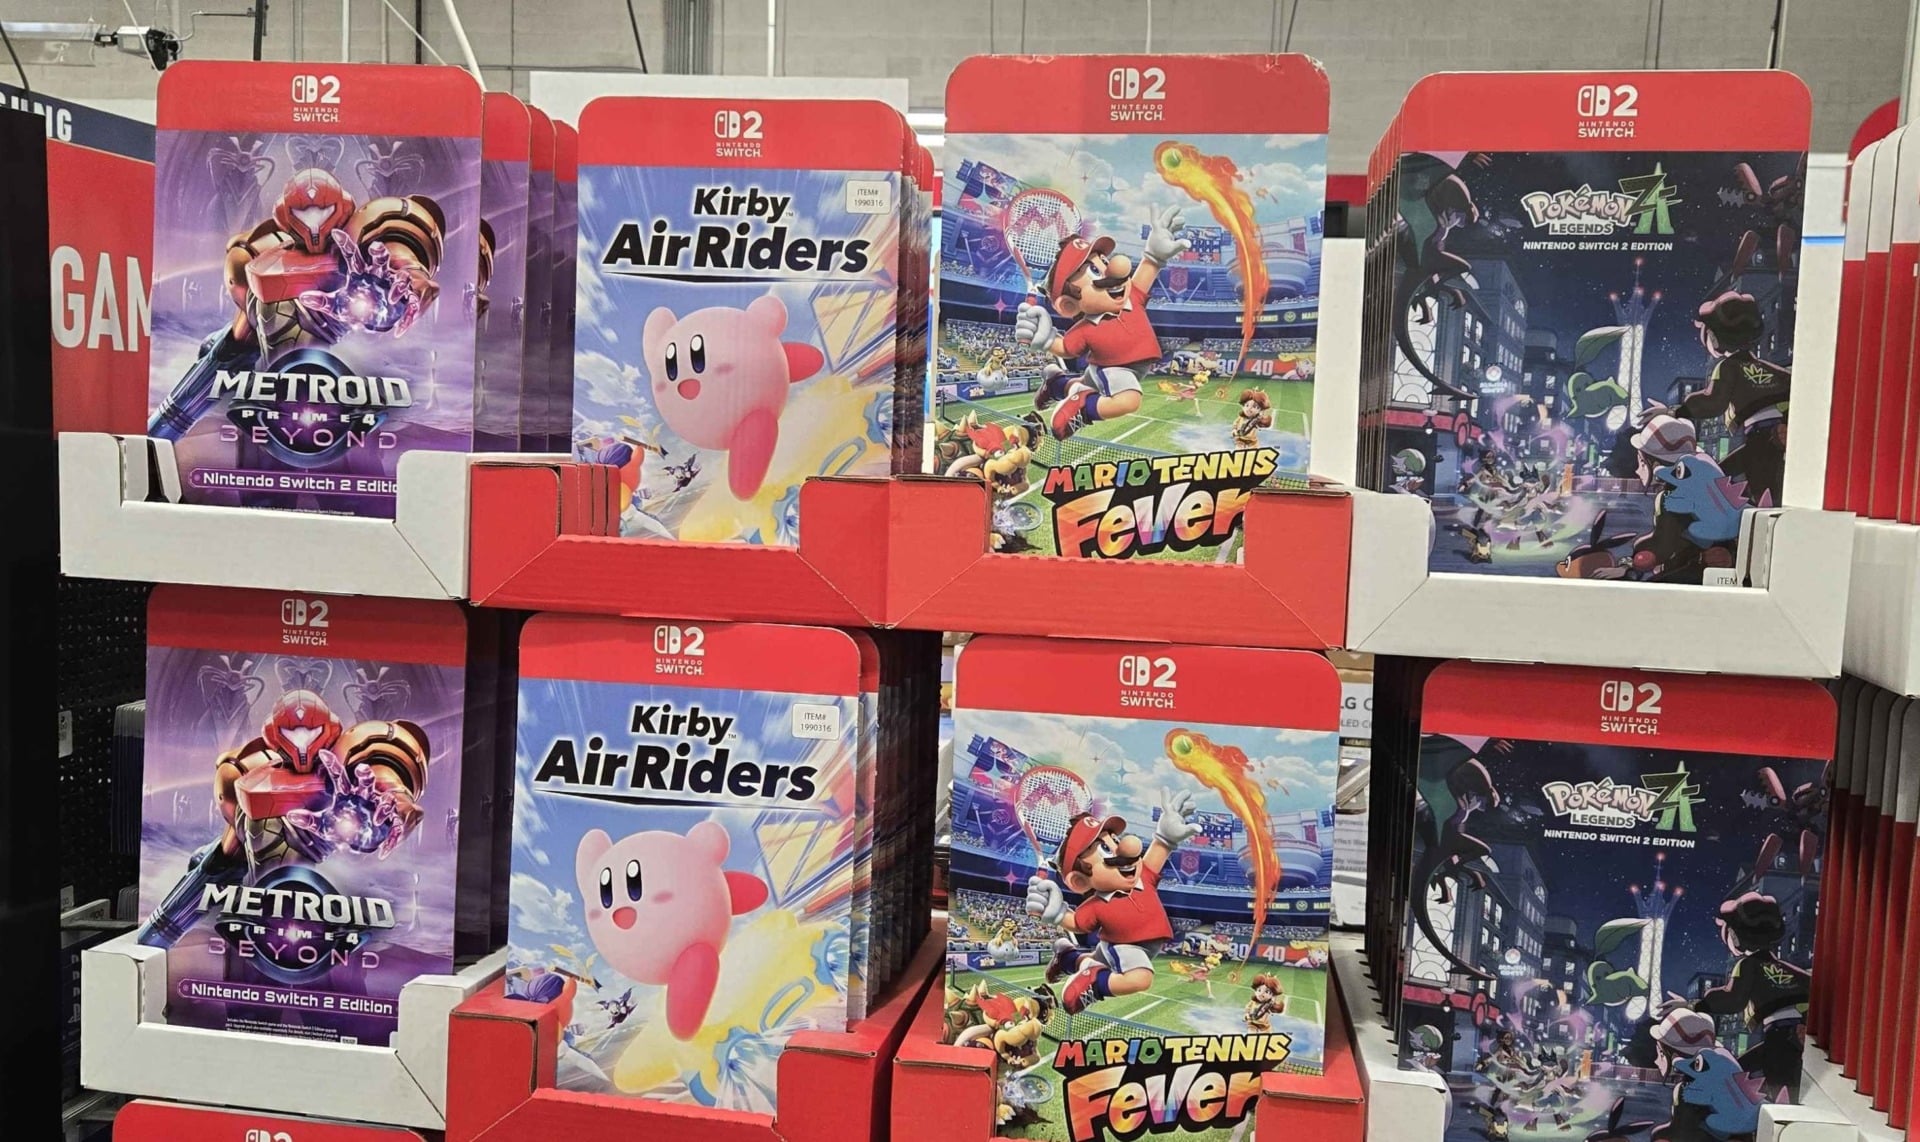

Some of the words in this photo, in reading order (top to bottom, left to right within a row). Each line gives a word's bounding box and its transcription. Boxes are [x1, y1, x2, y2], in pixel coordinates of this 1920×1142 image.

[293, 113, 339, 123] SWITCH
[1110, 111, 1164, 121] SWITCH
[1578, 120, 1635, 128] NINTENDO
[1578, 127, 1635, 138] SWITCH
[715, 147, 762, 158] SWITCH
[857, 188, 879, 196] ITEM#
[693, 186, 791, 223] Kirby
[854, 199, 884, 207] 1990316
[1551, 223, 1613, 235] LEGENDS
[602, 219, 691, 267] Air
[693, 222, 871, 274] Riders
[1523, 241, 1576, 251] NINTENDO
[1578, 241, 1619, 251] SWITCH
[1621, 241, 1629, 251] 2
[1631, 241, 1674, 251] EDITION
[1250, 359, 1275, 376] 40
[207, 369, 413, 408] METROID
[242, 410, 351, 423] PRIME
[362, 413, 377, 426] 4
[220, 425, 398, 450] BEYOND
[1043, 458, 1151, 494] MARIO
[1153, 448, 1278, 484] TENNIS
[203, 472, 274, 487] Nintendo
[279, 476, 335, 491] Switch
[340, 480, 352, 491] 2
[282, 629, 327, 637] NINTENDO
[282, 635, 328, 646] SWITCH
[655, 658, 703, 666] NINTENDO
[655, 664, 703, 676] SWITCH
[1121, 690, 1174, 698] NINTENDO
[1121, 696, 1175, 709] SWITCH
[804, 712, 827, 721] ITEM#
[1601, 715, 1658, 724] NINTENDO
[630, 704, 734, 745] Kirby
[800, 723, 832, 733] 1990316
[1600, 722, 1659, 735] SWITCH
[534, 737, 628, 787] Air
[630, 742, 819, 801] Riders
[1572, 813, 1635, 827] LEGENDS
[1544, 829, 1598, 841] NINTENDO
[1599, 833, 1641, 845] SWITCH
[1643, 836, 1650, 845] 2
[1652, 837, 1696, 848] EDITION
[196, 882, 396, 929] METROID
[229, 922, 335, 941] PRIME
[346, 933, 359, 945] 4
[208, 937, 380, 969] BEYOND
[1262, 945, 1286, 962] 40
[191, 983, 260, 1001] Nintendo
[264, 990, 319, 1008] Switch
[323, 996, 335, 1009] 2
[339, 998, 393, 1015] Edition
[1054, 1038, 1163, 1068] MARIO
[1164, 1033, 1289, 1064] TENNIS
